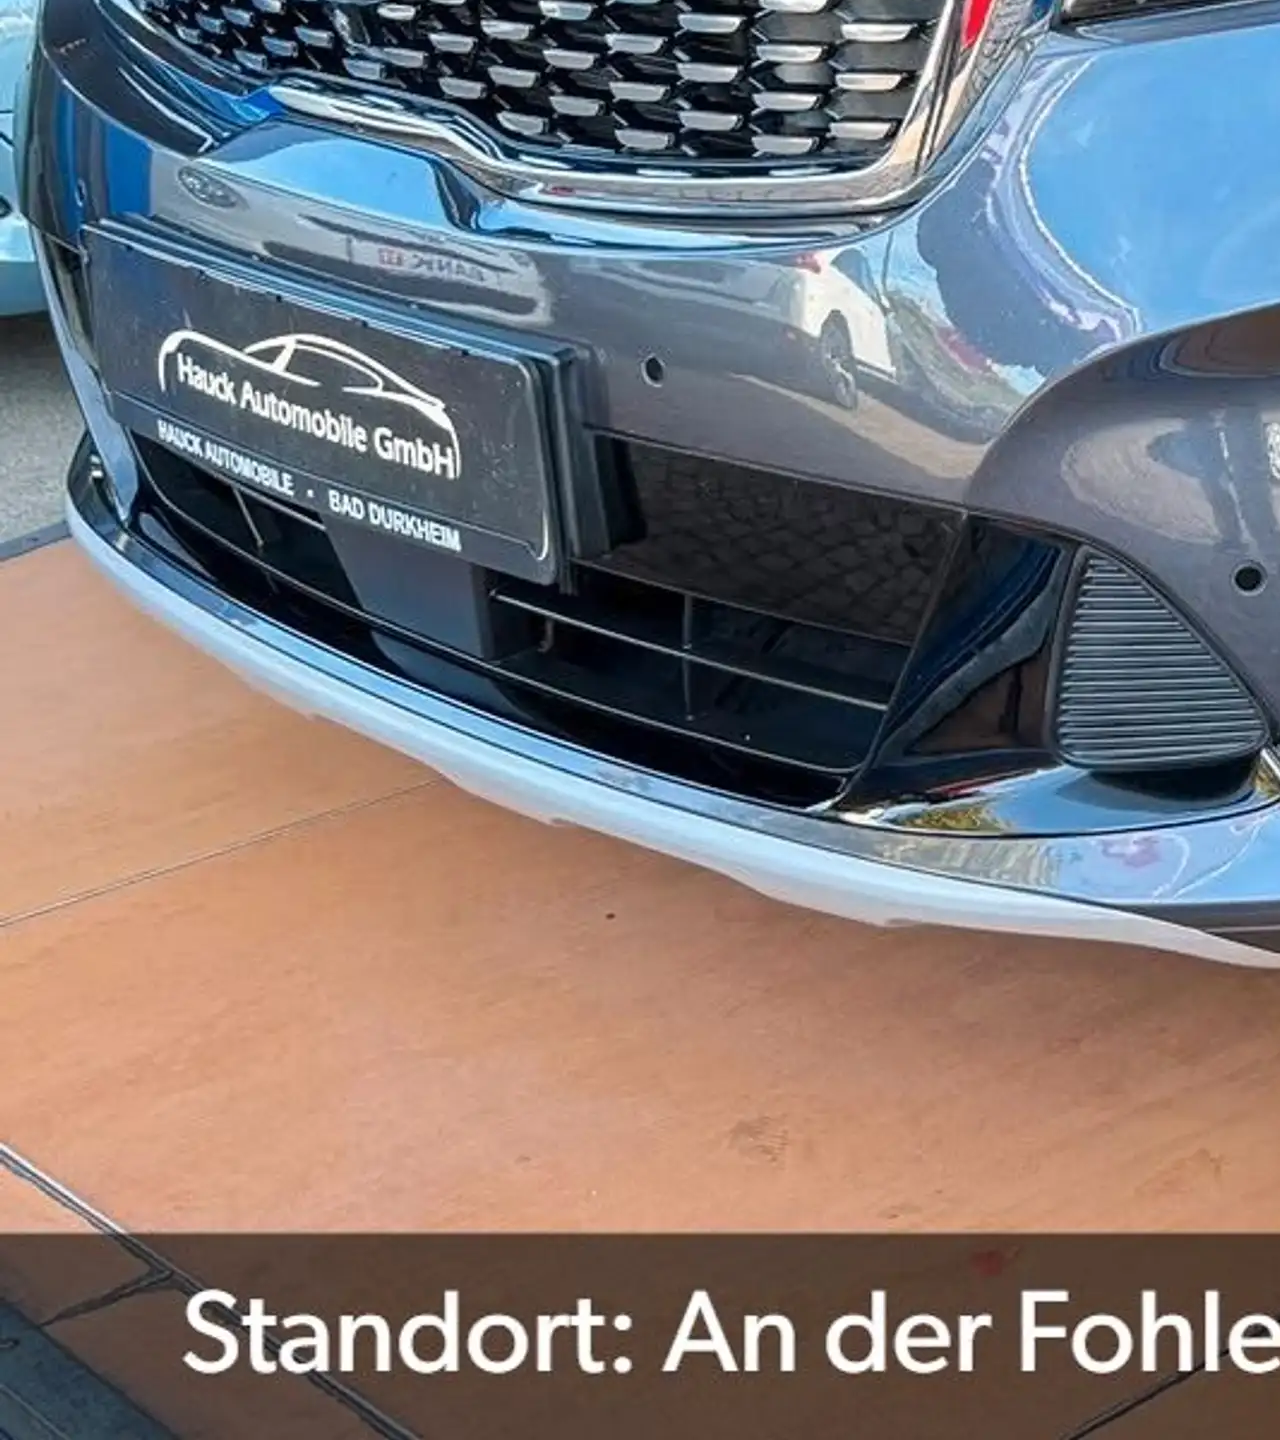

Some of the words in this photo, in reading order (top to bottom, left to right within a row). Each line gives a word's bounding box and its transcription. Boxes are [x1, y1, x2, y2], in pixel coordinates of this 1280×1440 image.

[156, 419, 204, 460] HAUCK
[204, 437, 296, 497] AUTOMOBILE
[327, 488, 366, 522] BAD
[176, 352, 236, 406] Hauck
[240, 382, 369, 453] Automobile
[373, 426, 456, 481] GmbH
